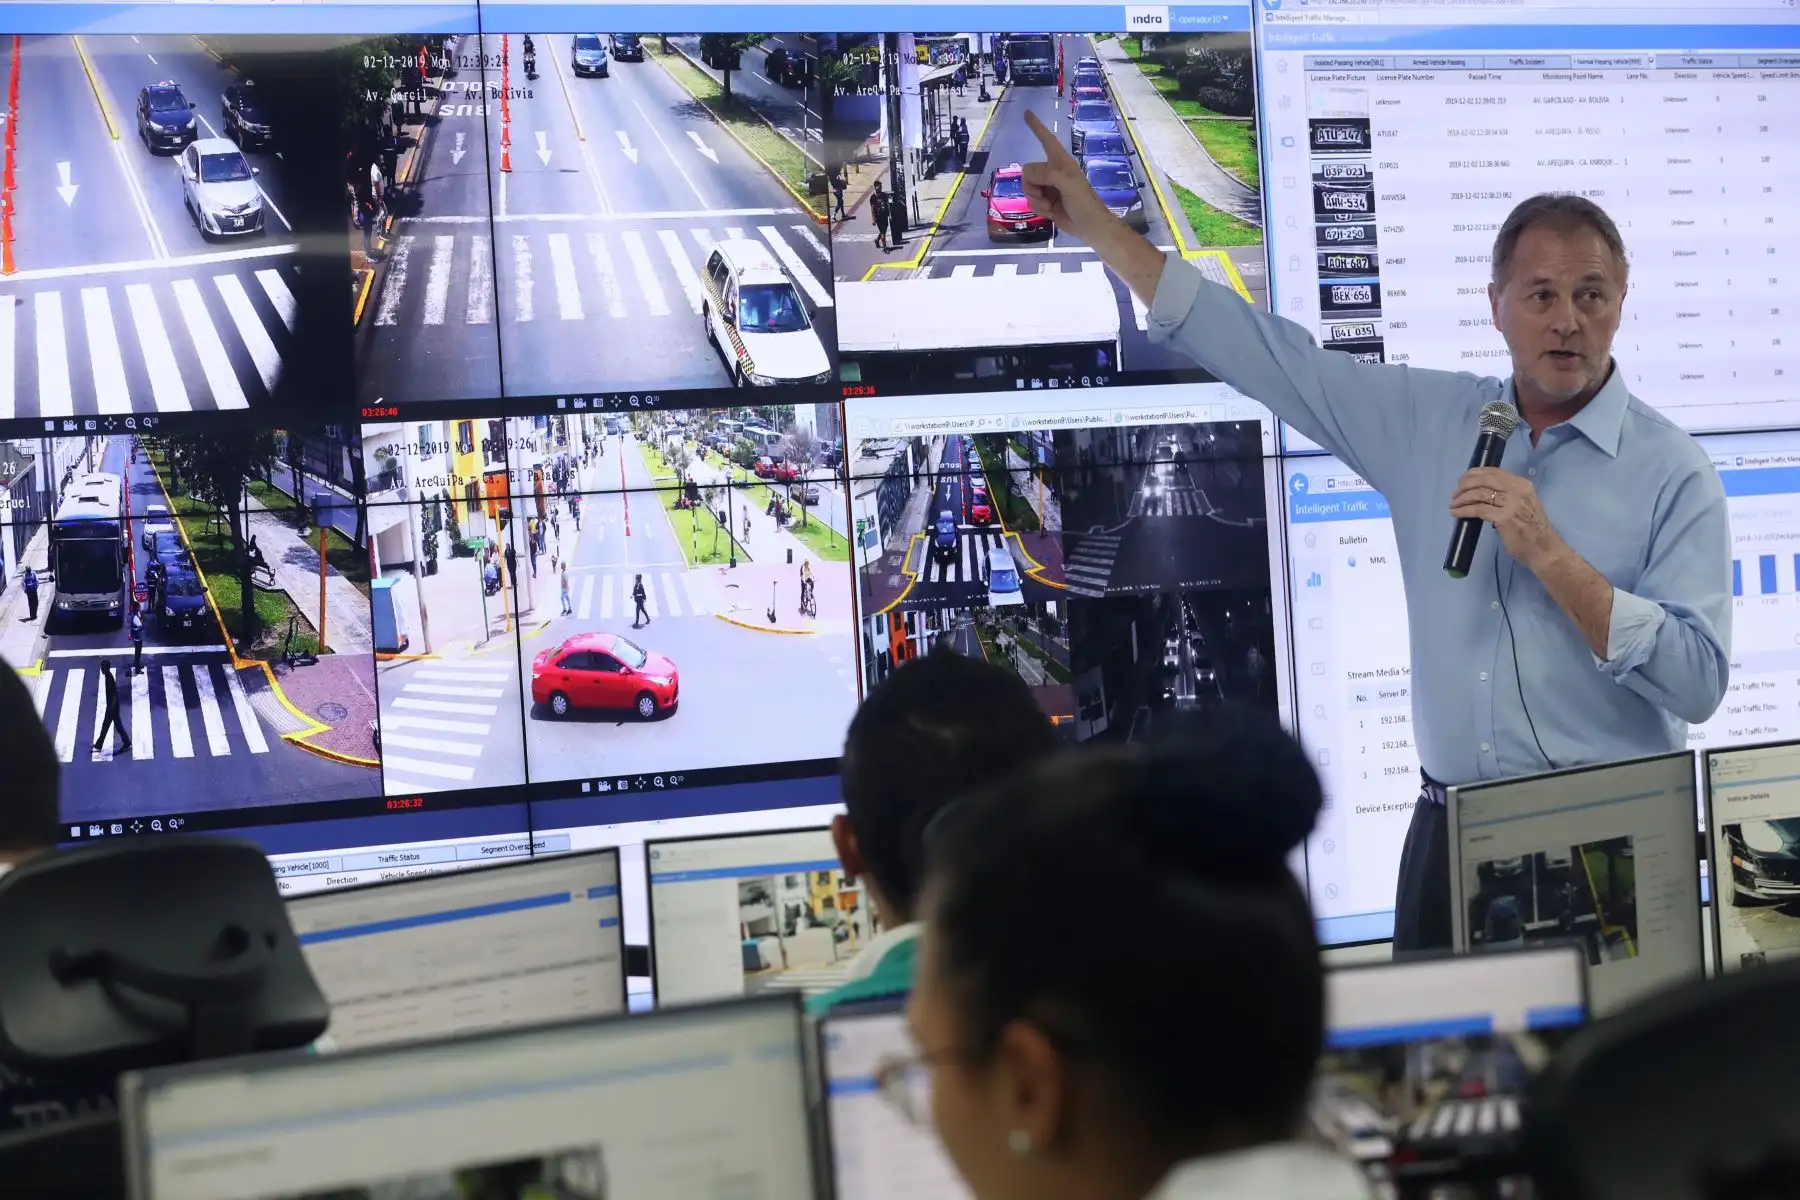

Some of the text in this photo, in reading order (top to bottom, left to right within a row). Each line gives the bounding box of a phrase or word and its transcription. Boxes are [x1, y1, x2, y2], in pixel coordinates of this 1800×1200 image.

[1133, 14, 1162, 24] indra
[1295, 503, 1340, 516] Intelligent
[1342, 501, 1369, 512] Traffic
[1339, 536, 1368, 545] Bulletin
[1347, 668, 1400, 680] Stream Media
[1378, 690, 1399, 699] Server
[1356, 805, 1381, 815] Device
[481, 845, 508, 854] Segment
[378, 853, 421, 864] Traffic Status
[326, 876, 358, 885] Direction
